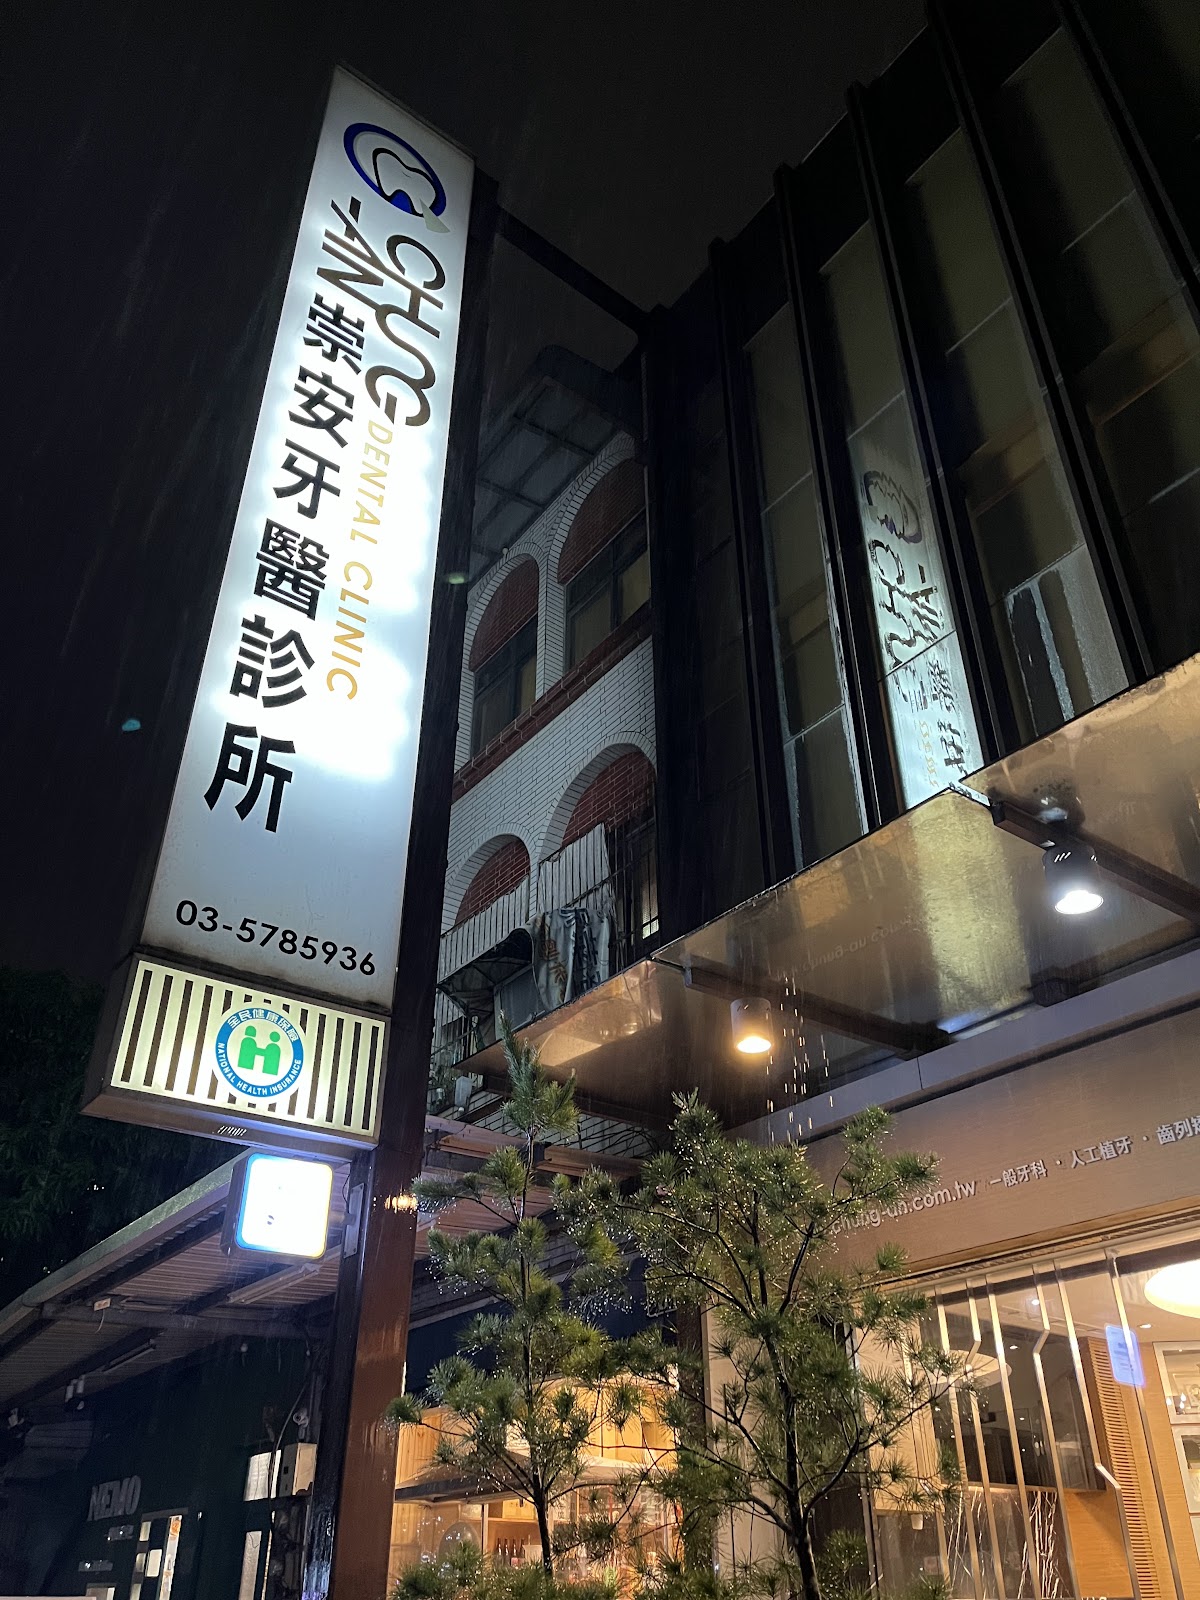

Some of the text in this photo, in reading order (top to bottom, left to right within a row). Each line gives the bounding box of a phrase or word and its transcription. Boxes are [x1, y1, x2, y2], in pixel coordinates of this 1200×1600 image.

[204, 292, 366, 834] 崇安牙醫診所
[326, 419, 395, 701] DENTAL CLINIC
[175, 899, 377, 977] 03-5785936
[227, 1008, 299, 1042] 全民健康保險
[217, 1042, 302, 1096] NATIONAL HEALTH INSURANCE
[989, 1159, 1048, 1187] 一般牙科
[1070, 1136, 1133, 1169] 人工植牙
